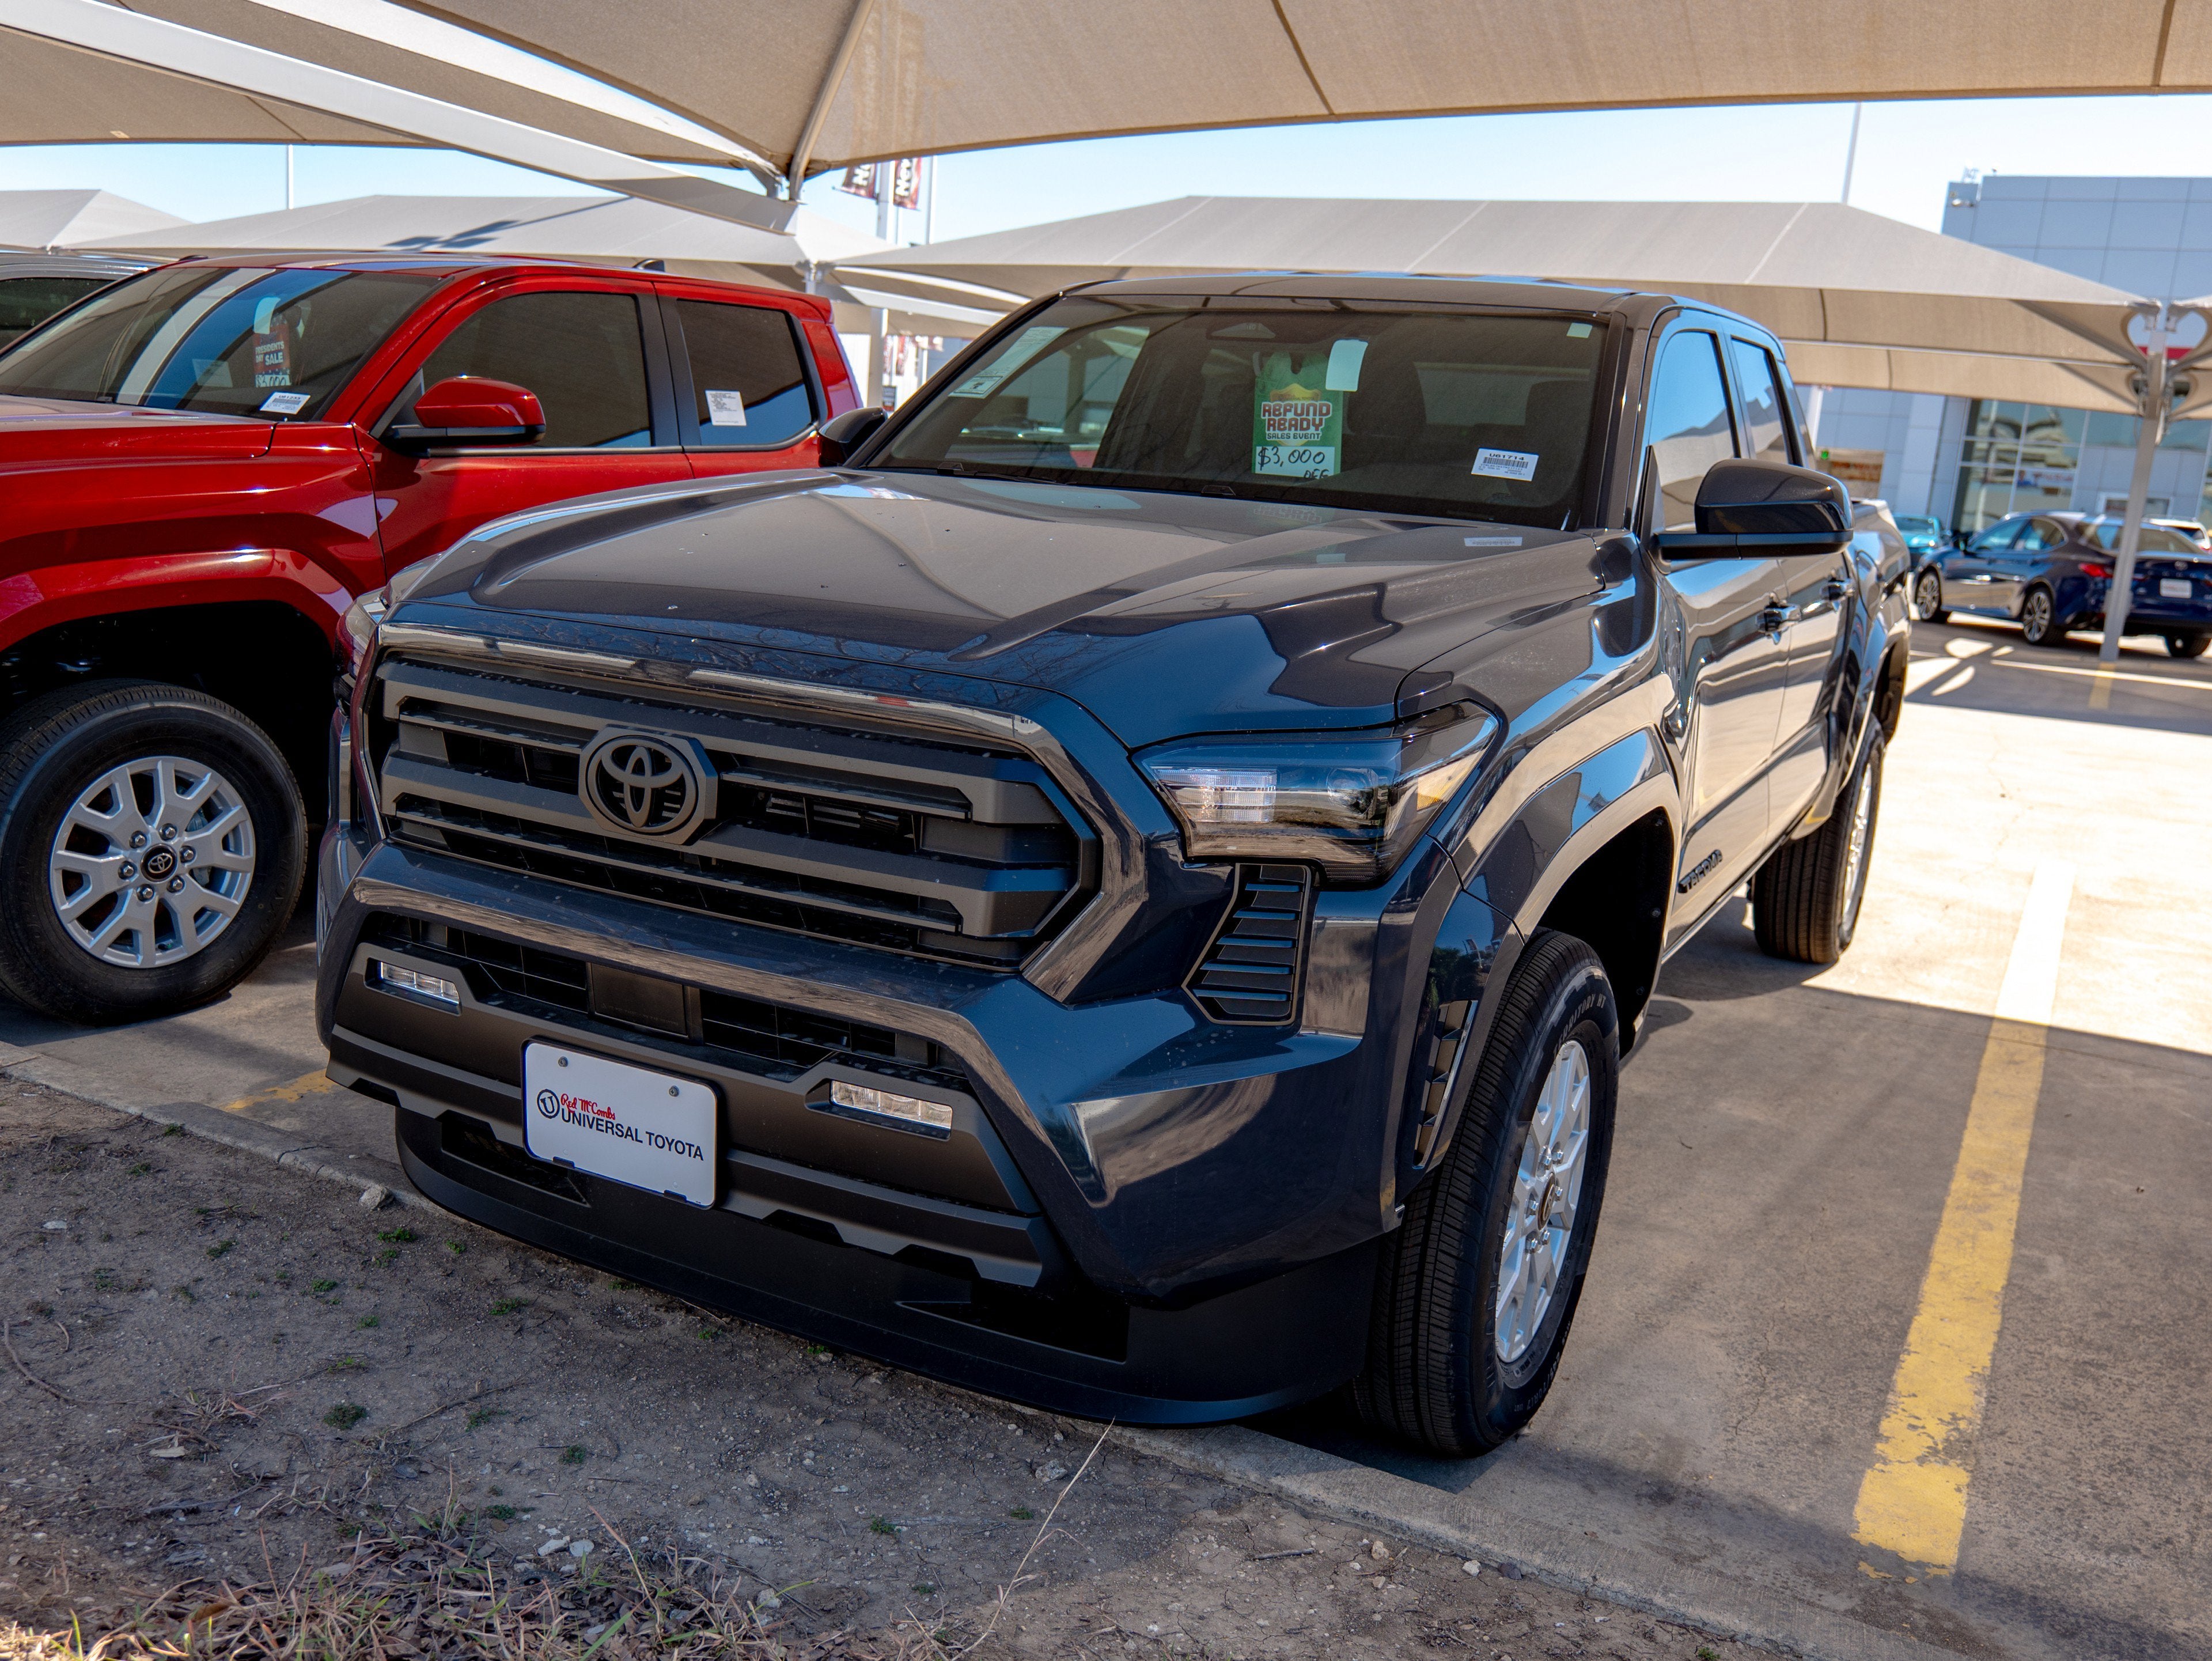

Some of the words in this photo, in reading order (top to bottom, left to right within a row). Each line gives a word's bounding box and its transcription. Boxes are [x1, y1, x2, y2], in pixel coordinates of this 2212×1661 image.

[255, 341, 285, 354] PRESIDENTS
[256, 354, 264, 363] DAY
[265, 351, 283, 365] SALE
[1262, 403, 1331, 417] REFUND
[1267, 417, 1323, 432] READY
[1258, 447, 1325, 471] $3,000
[1678, 849, 1723, 894] TACOMA
[561, 1094, 577, 1113] Red
[562, 1108, 643, 1143] UNIVERSAL
[645, 1131, 704, 1161] TOYOTA
